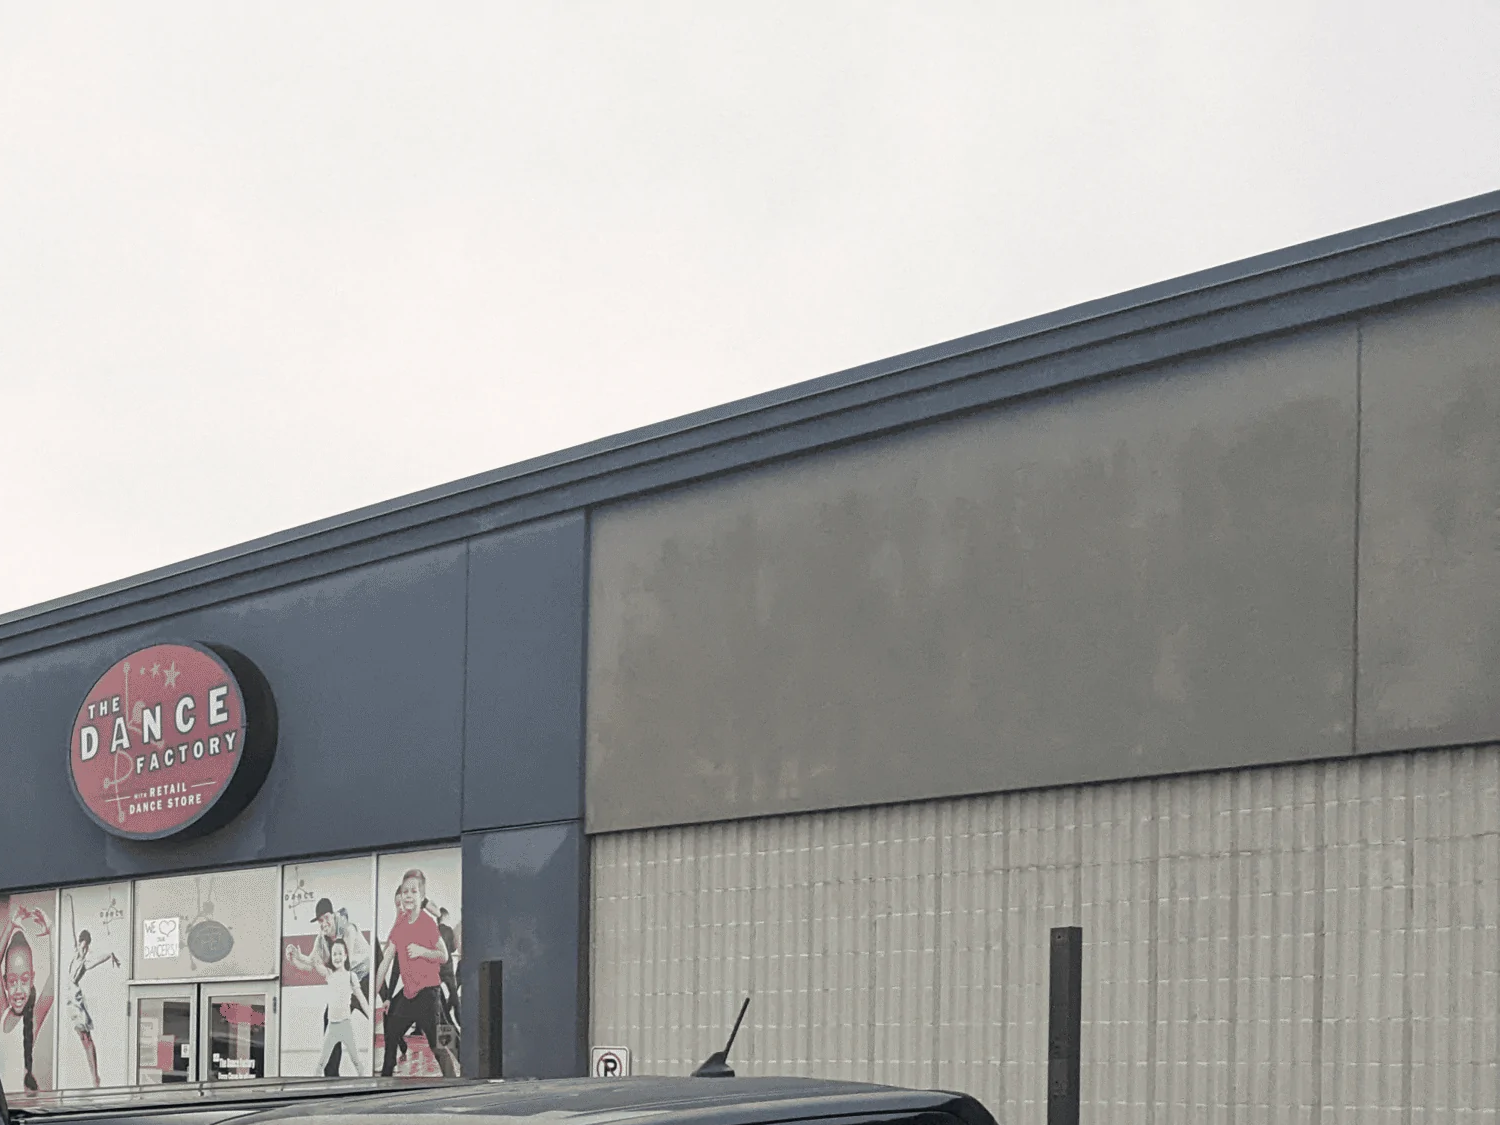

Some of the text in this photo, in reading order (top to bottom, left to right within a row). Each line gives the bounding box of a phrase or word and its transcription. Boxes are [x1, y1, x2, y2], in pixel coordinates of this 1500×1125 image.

[88, 696, 120, 720] THE
[80, 685, 228, 761] DANCE
[136, 731, 237, 774] FACTORY
[149, 782, 187, 797] RETAIL
[129, 793, 202, 815] DANCE STORE
